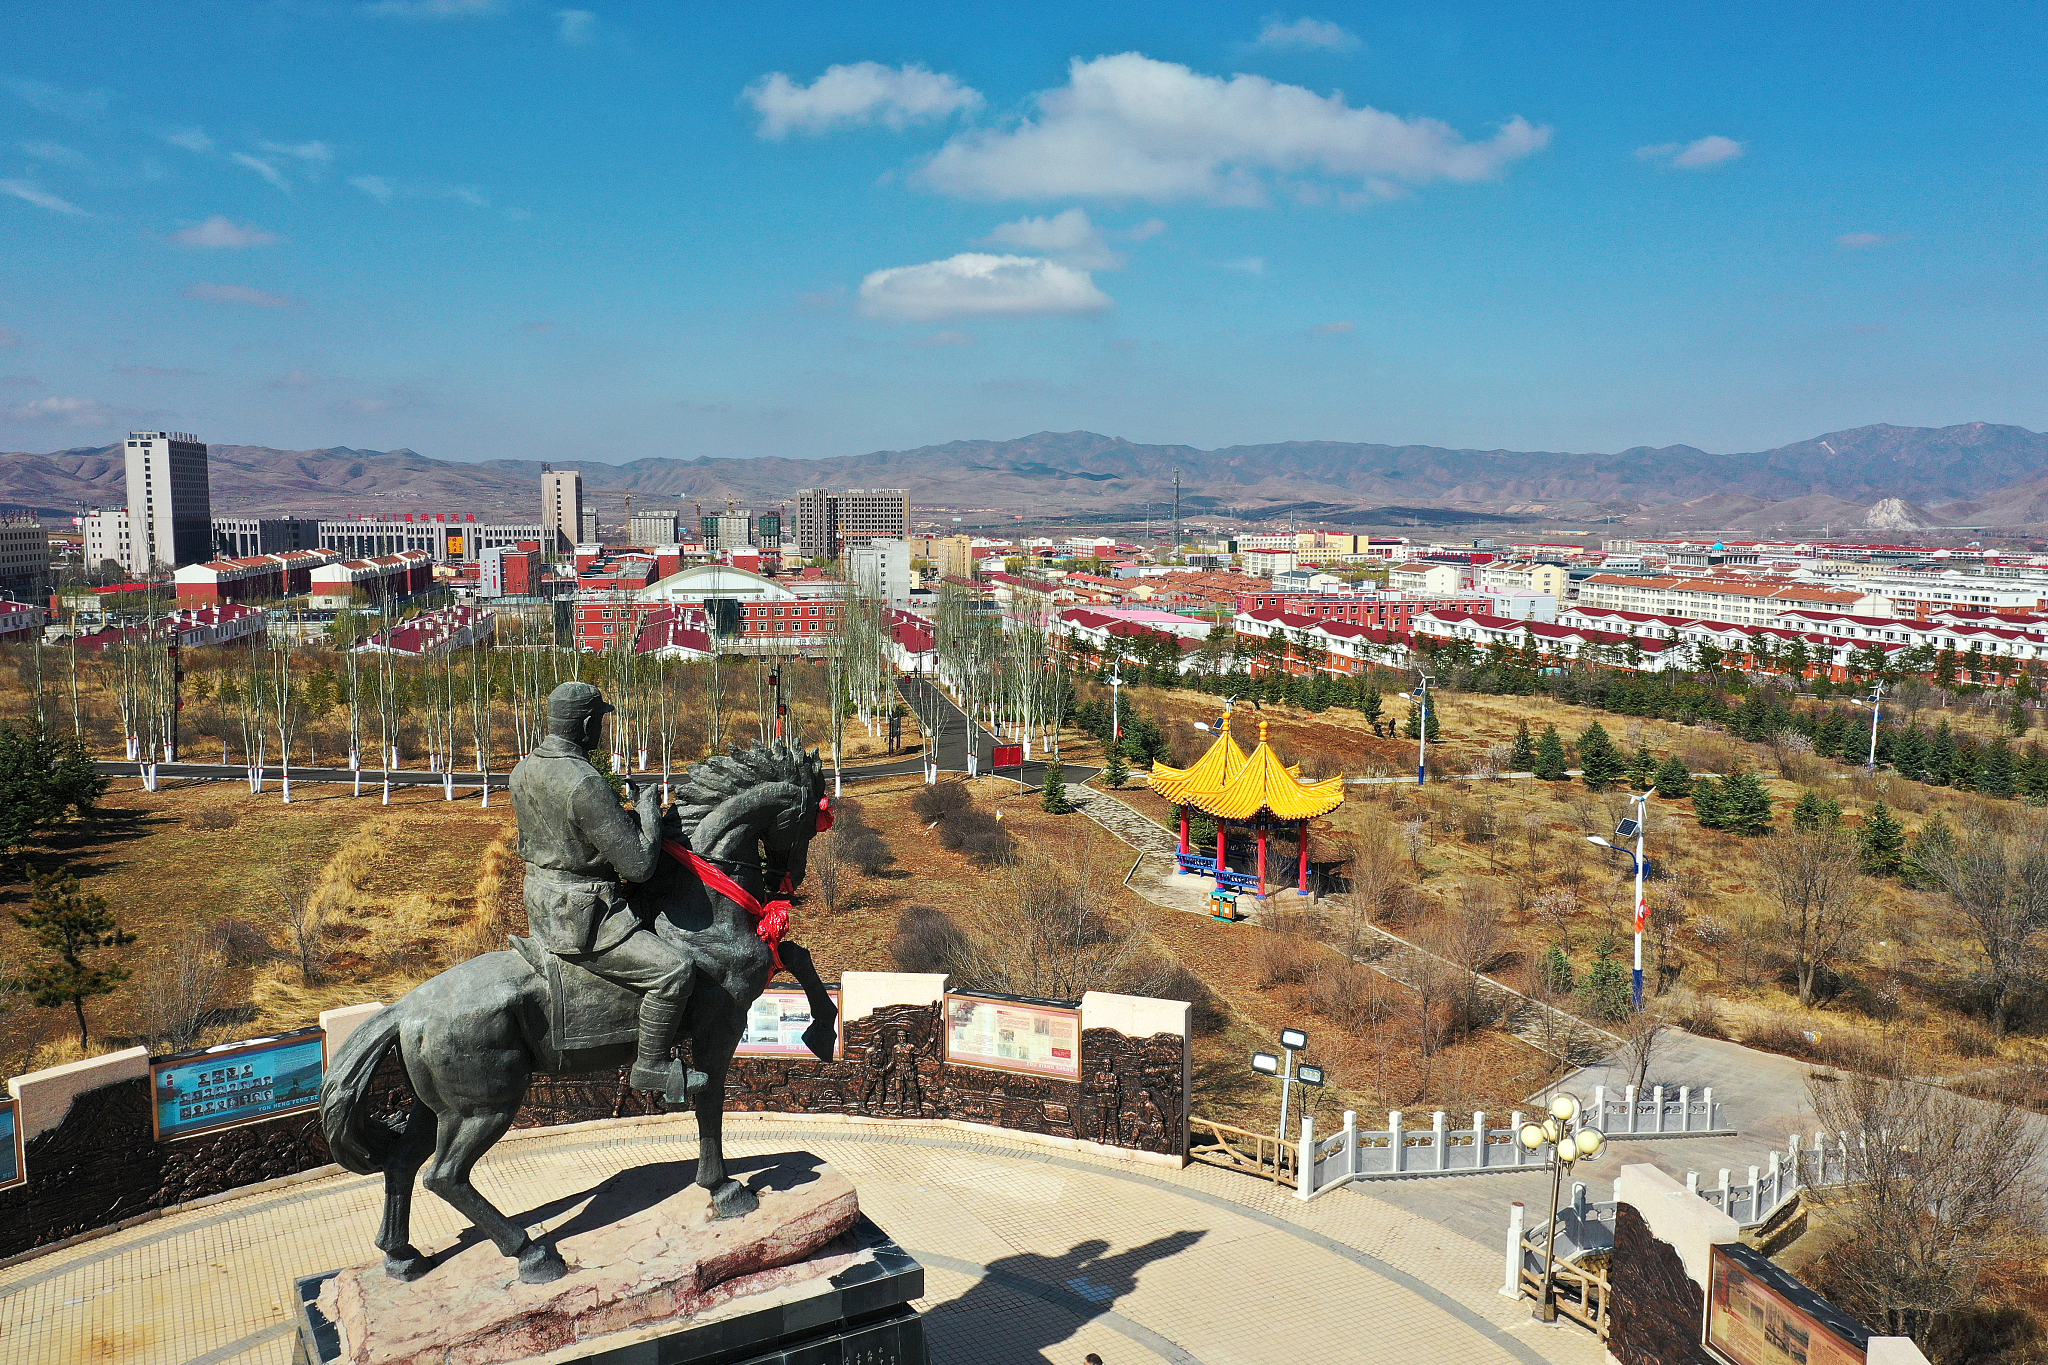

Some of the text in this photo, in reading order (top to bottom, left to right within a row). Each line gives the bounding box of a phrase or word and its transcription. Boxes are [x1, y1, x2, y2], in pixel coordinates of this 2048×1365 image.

[404, 513, 476, 522] 富华新天地
